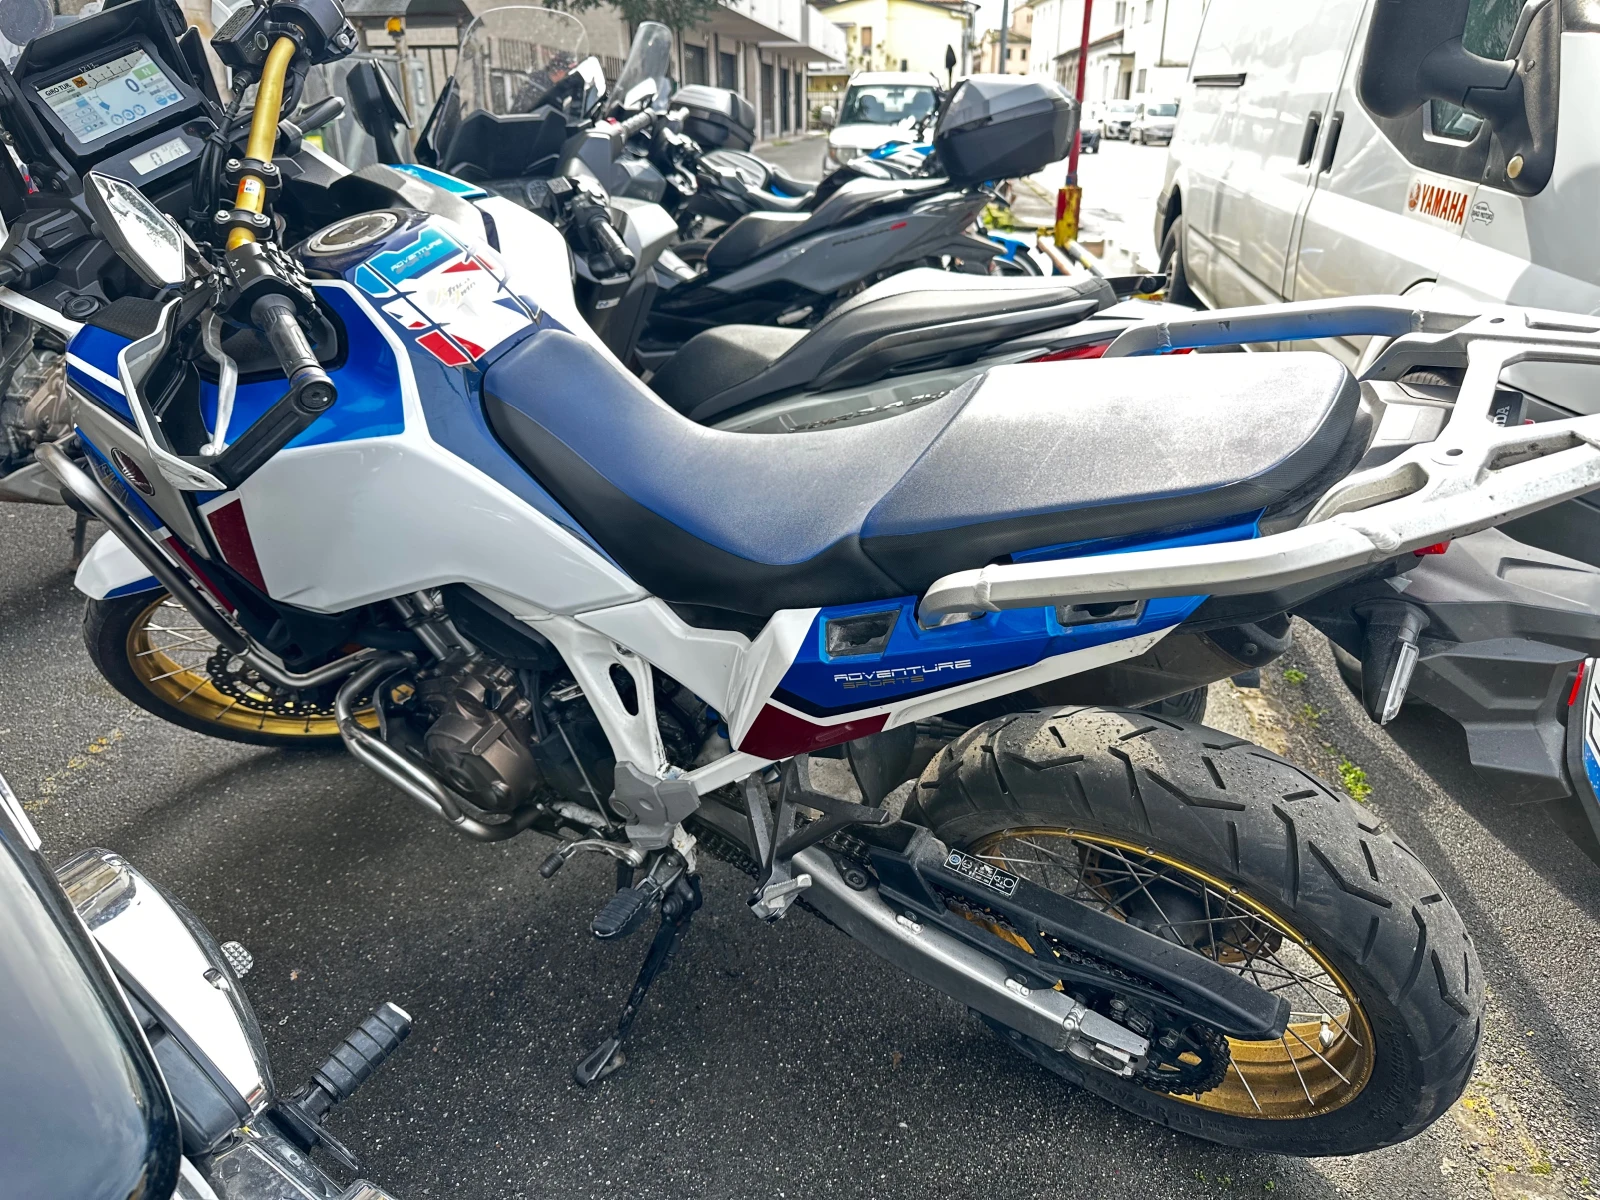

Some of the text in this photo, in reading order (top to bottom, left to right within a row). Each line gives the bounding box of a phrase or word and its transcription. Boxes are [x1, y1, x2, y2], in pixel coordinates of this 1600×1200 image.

[141, 67, 152, 77] N
[45, 87, 60, 96] GIRO
[125, 78, 140, 92] 0
[1419, 183, 1469, 226] YAMAHA
[390, 238, 443, 272] ADVENTURE
[833, 659, 972, 683] ADVENTURE
[842, 675, 925, 690] SPORTS
